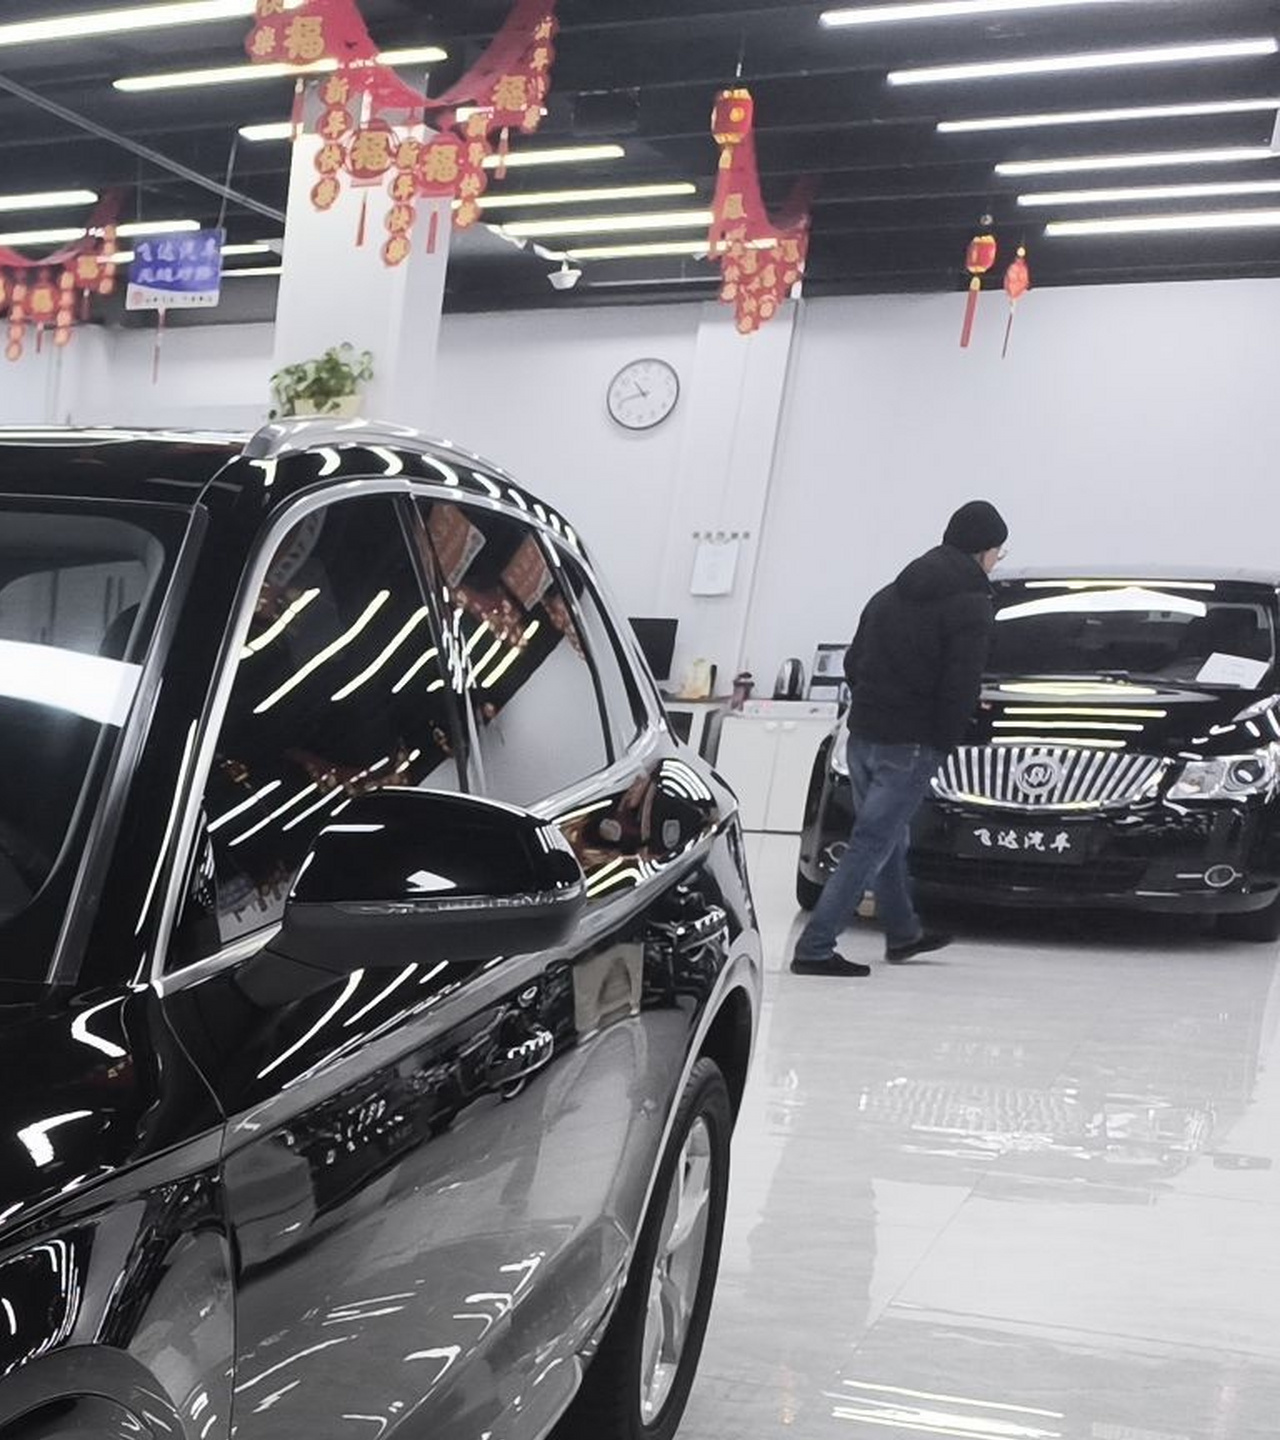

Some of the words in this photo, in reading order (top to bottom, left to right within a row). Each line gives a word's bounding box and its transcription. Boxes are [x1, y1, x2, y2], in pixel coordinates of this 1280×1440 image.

[283, 15, 325, 59] 福
[421, 145, 460, 183] 福
[973, 828, 1071, 854] 飞达汽车
